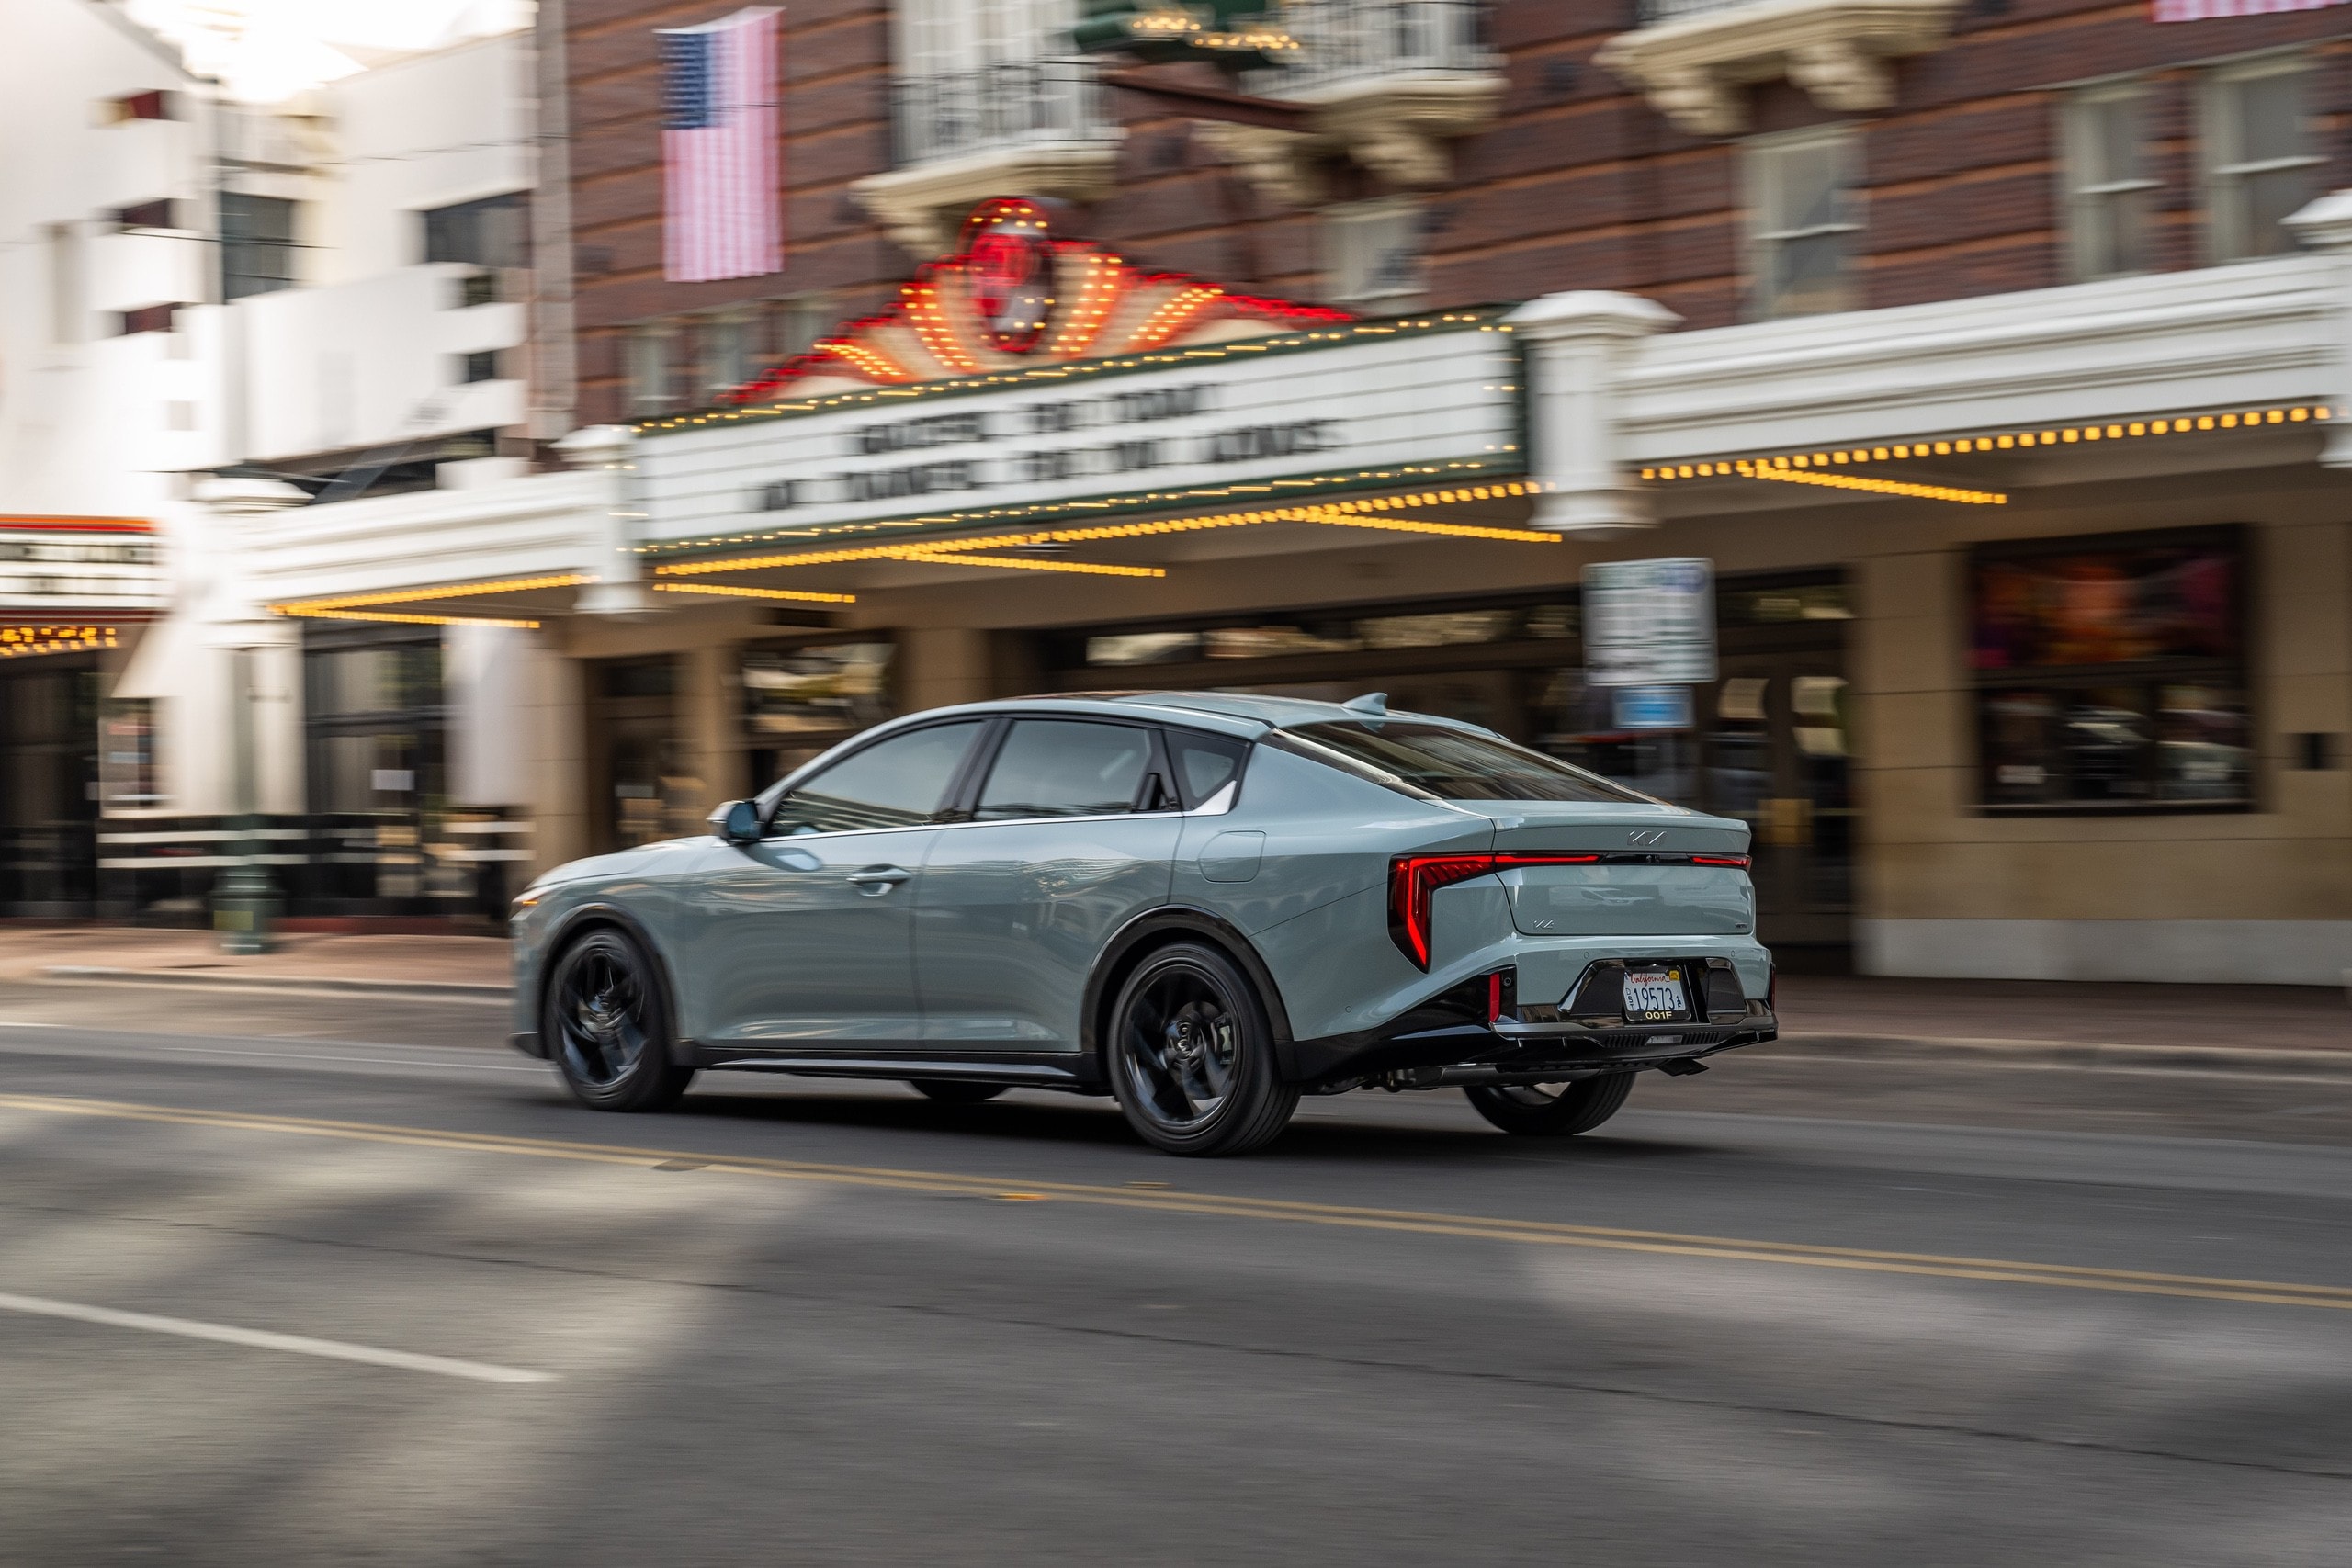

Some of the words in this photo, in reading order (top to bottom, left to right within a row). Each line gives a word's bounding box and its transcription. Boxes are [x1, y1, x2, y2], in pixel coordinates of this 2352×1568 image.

[1630, 973, 1668, 987] California
[1634, 987, 1675, 1010] 19573
[1645, 1011, 1672, 1020] 001F
